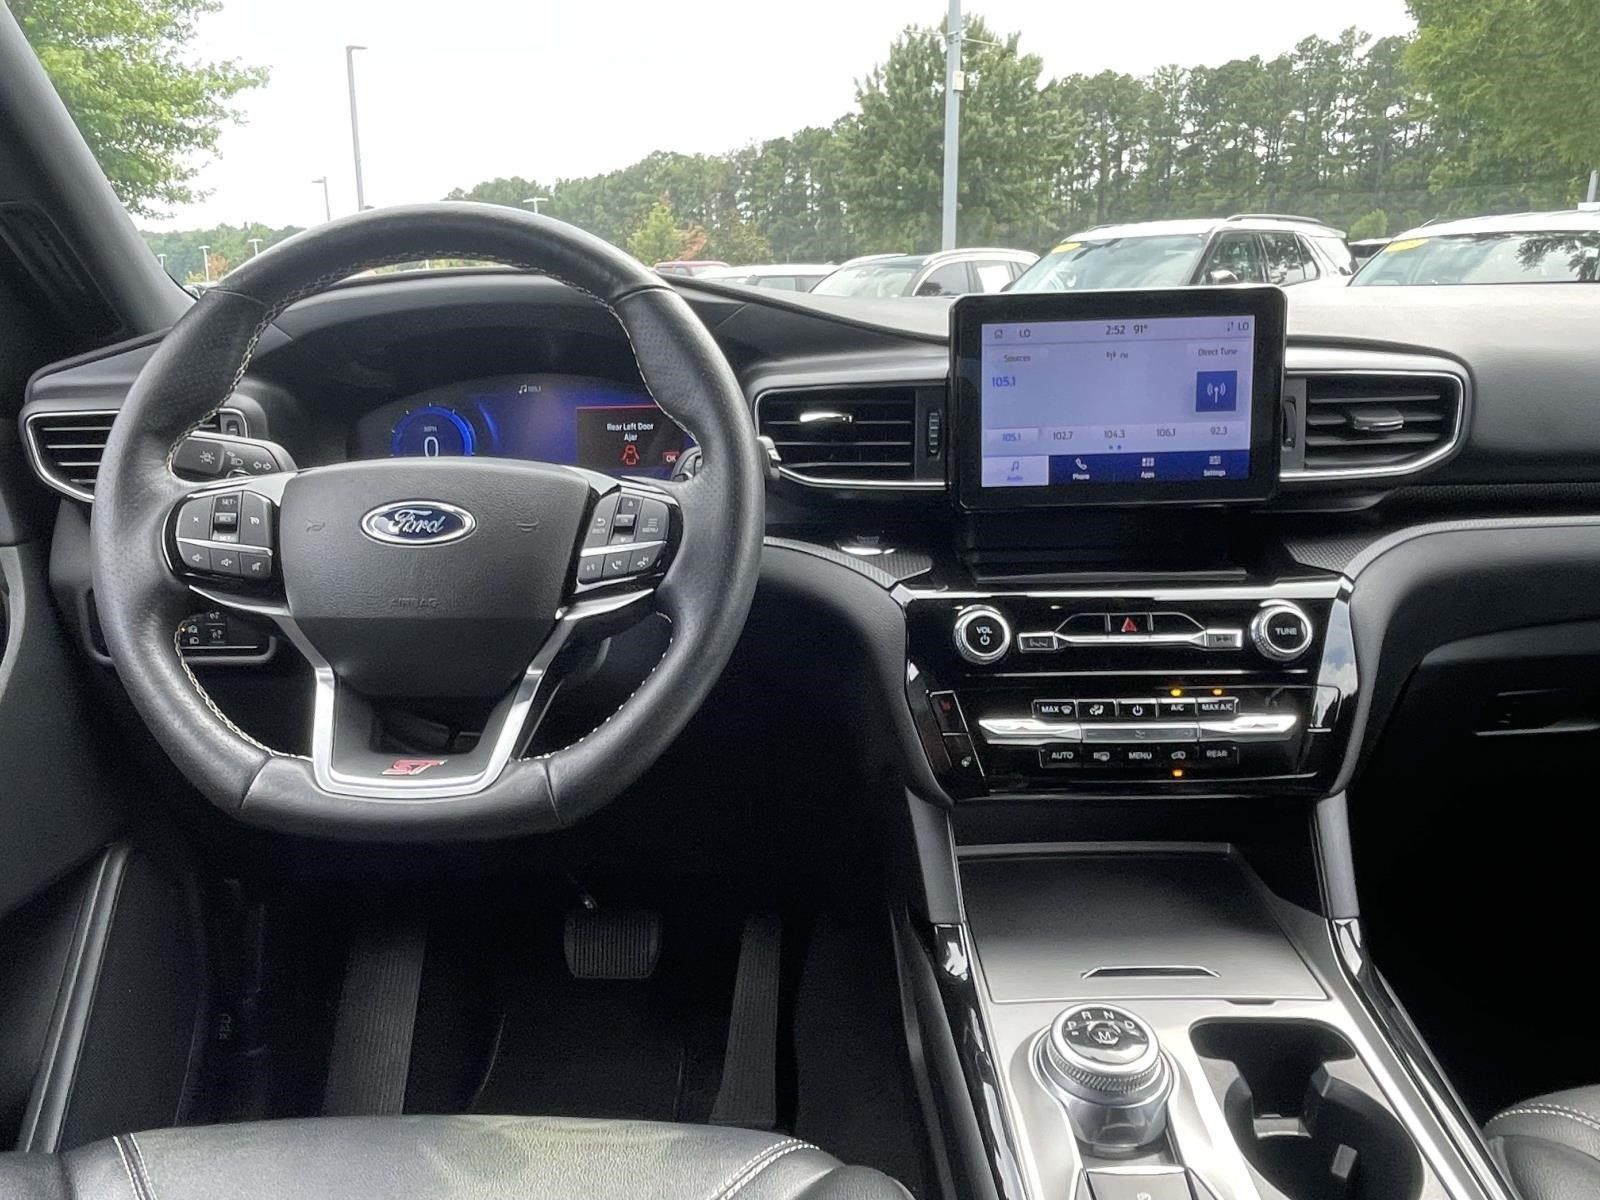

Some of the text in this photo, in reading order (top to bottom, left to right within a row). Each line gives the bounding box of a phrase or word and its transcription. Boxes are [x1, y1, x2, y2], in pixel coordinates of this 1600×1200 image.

[1105, 324, 1148, 336] 2:52 91°
[1238, 321, 1250, 331] LO
[1019, 329, 1031, 338] LO
[1198, 346, 1238, 357] Direct Tune
[1004, 354, 1031, 363] Sources
[992, 376, 1016, 387] 105.1
[606, 422, 654, 431] Rear Left Door
[1210, 426, 1228, 435] 92.3
[1053, 431, 1073, 440] 102.7
[1104, 429, 1125, 438] 104.3
[1156, 428, 1176, 437] 106.1
[624, 433, 638, 442] Ajar
[424, 436, 439, 457] 0
[388, 508, 446, 534] Ford
[976, 626, 993, 634] VOL
[1275, 627, 1297, 636] TUNE
[1041, 705, 1060, 713] MAX
[1201, 703, 1234, 711] MAX A/C
[1051, 751, 1074, 760] AUTO
[1128, 751, 1153, 760] MENU
[1206, 750, 1228, 758] REAR
[1081, 1011, 1092, 1020] R
[1103, 1010, 1115, 1020] N
[1066, 1020, 1077, 1031] P
[1123, 1020, 1135, 1029] D
[1098, 1031, 1111, 1041] M
